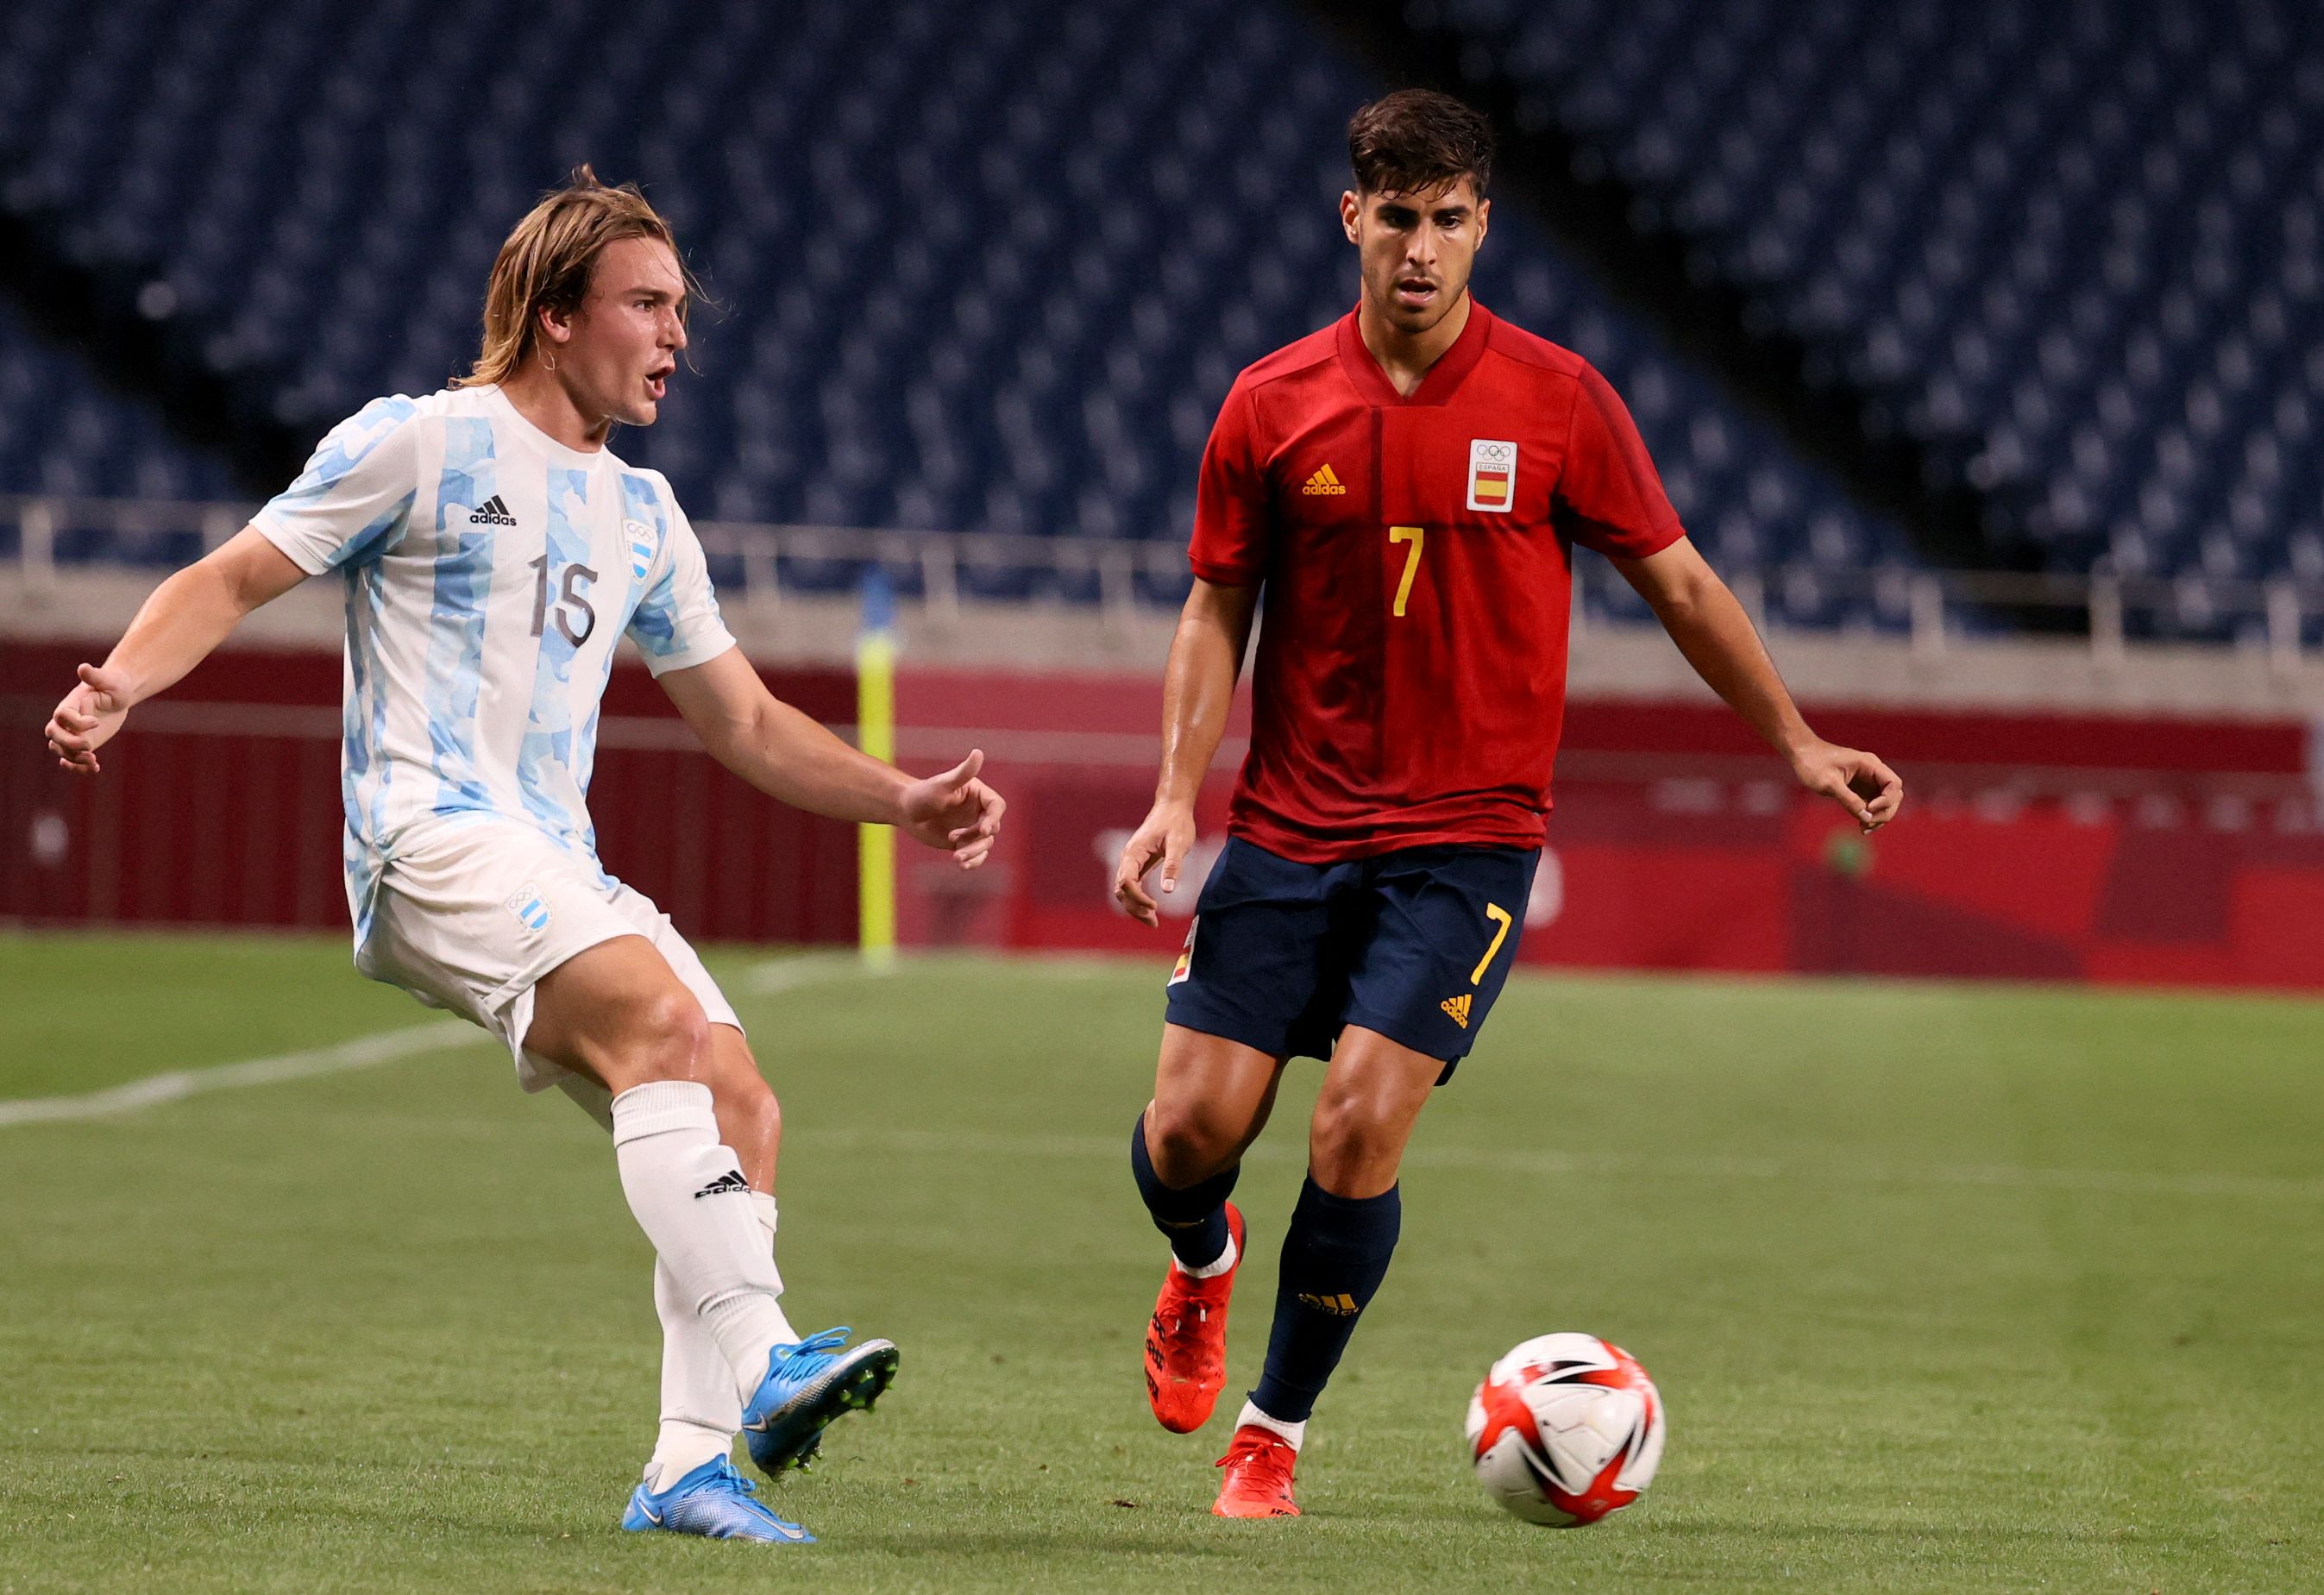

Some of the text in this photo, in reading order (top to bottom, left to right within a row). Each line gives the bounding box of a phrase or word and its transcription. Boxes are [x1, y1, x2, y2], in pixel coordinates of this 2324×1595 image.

[469, 512, 517, 526] adidas
[1303, 483, 1347, 495] adidas
[528, 554, 598, 648] 15
[1389, 526, 1424, 617] 7
[1470, 902, 1512, 986] 7
